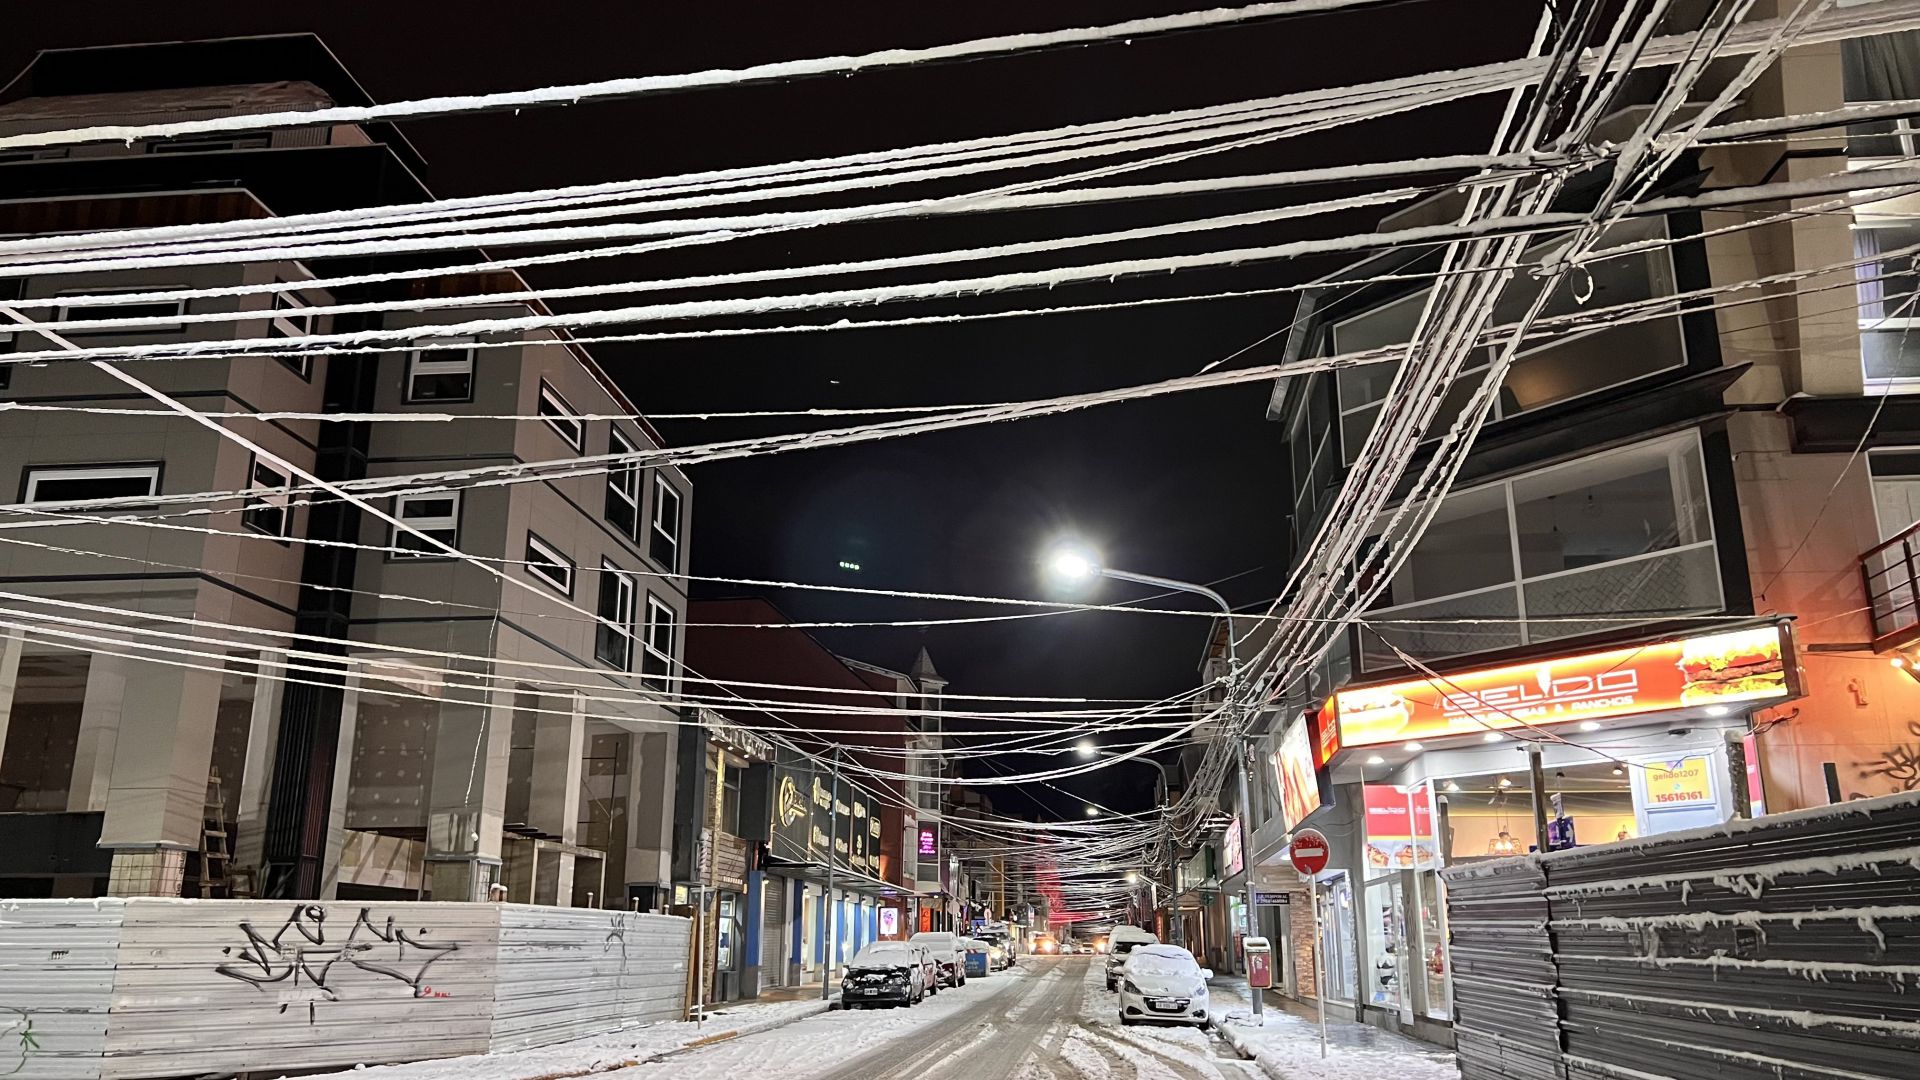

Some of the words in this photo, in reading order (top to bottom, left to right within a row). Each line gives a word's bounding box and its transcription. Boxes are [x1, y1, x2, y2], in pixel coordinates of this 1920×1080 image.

[1571, 695, 1635, 712] PANCHOS
[1653, 768, 1700, 781] gelido1207
[1656, 791, 1703, 803] 15616161
